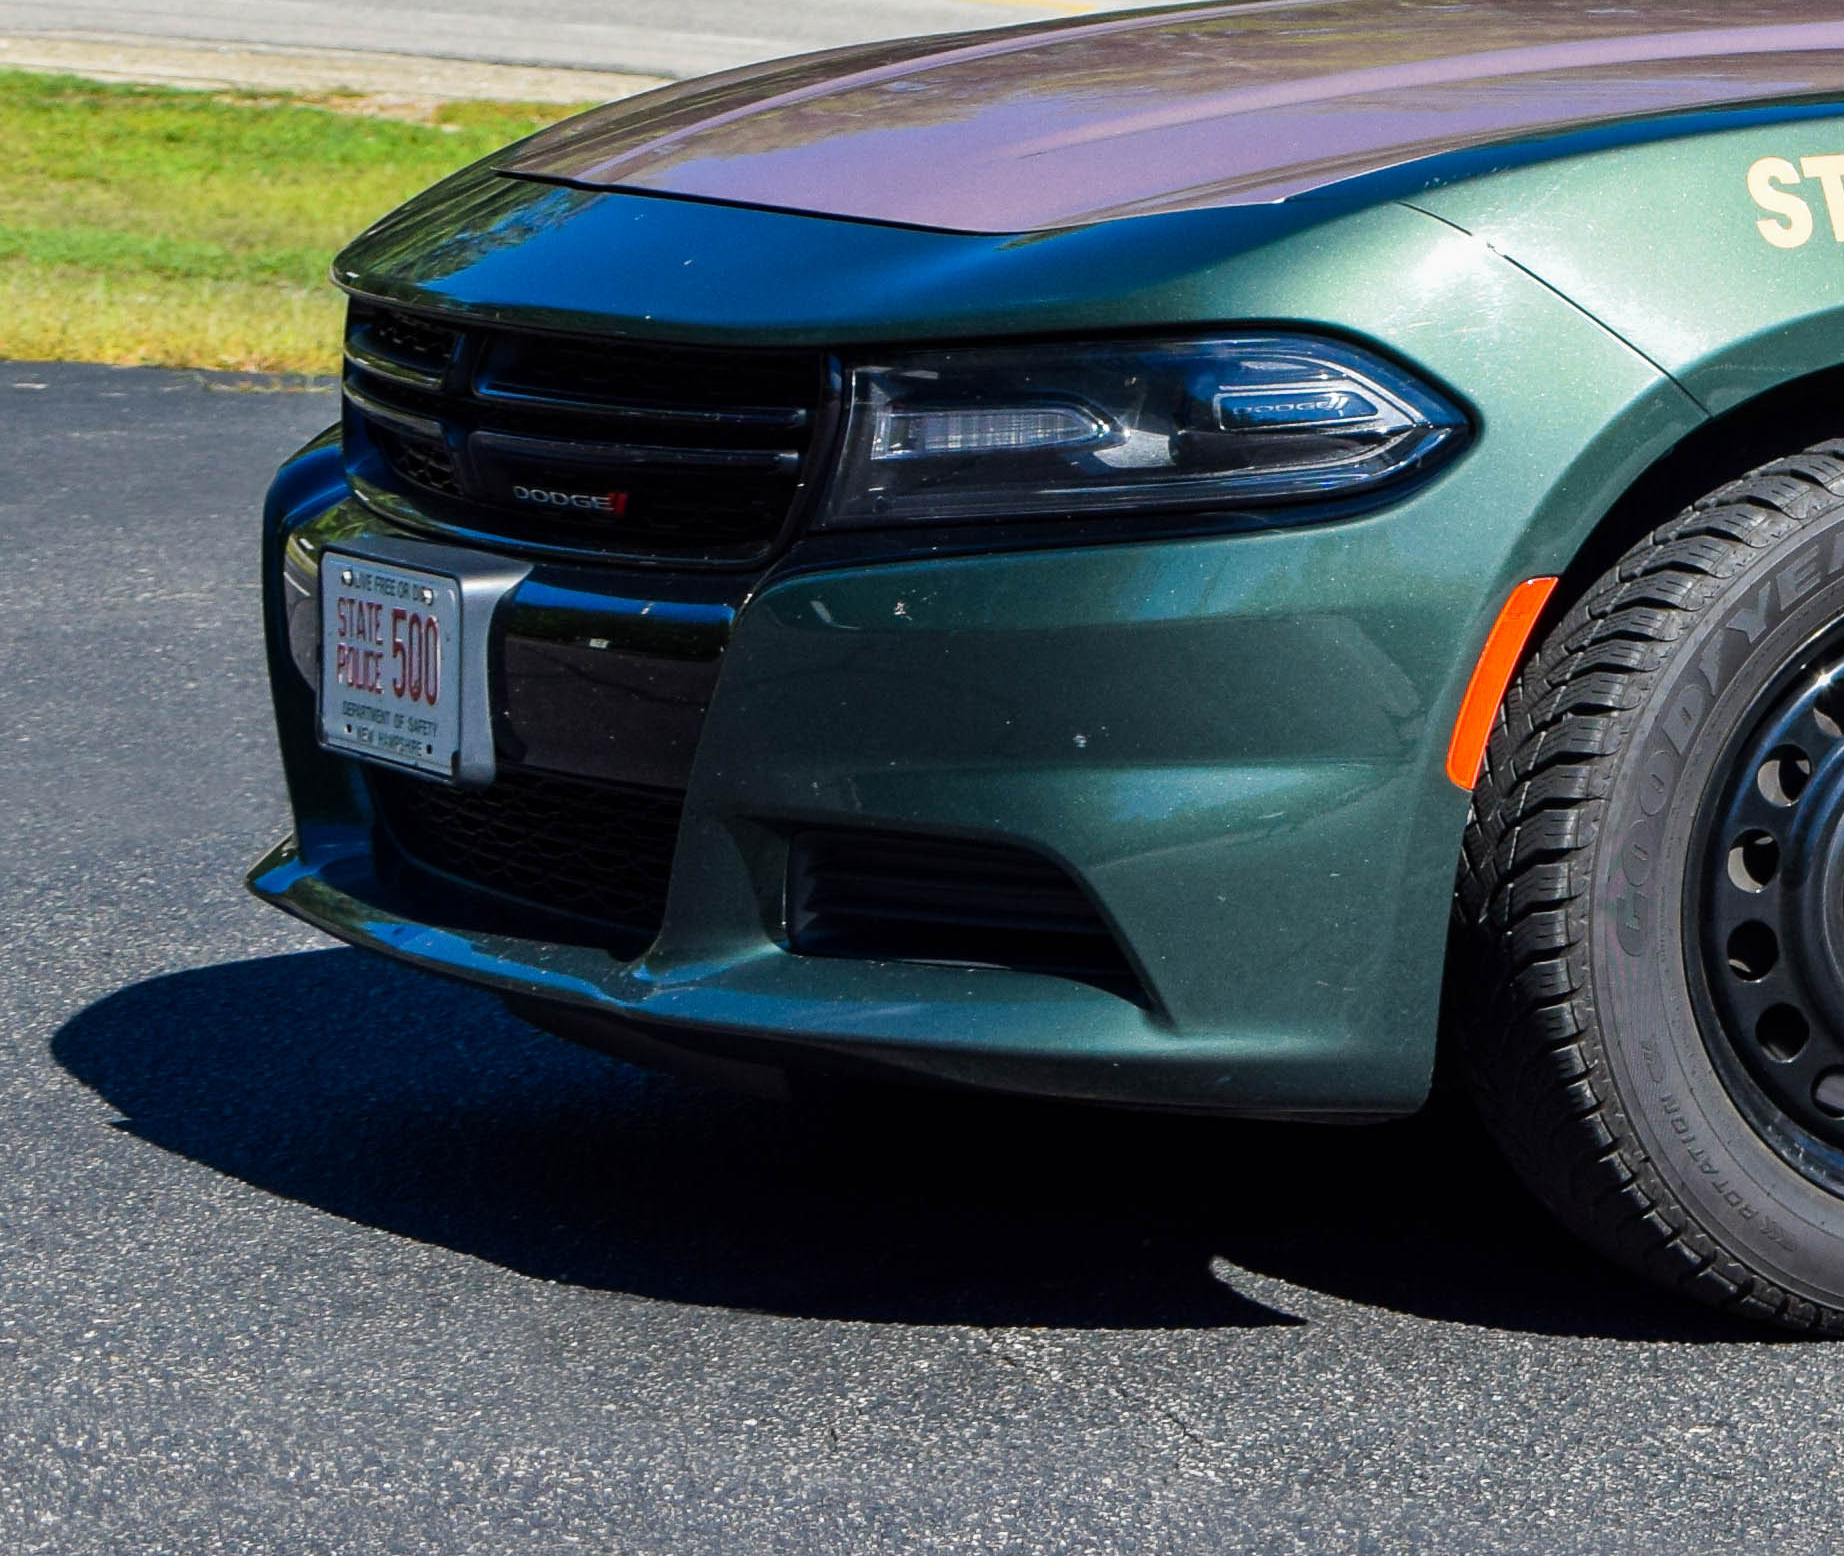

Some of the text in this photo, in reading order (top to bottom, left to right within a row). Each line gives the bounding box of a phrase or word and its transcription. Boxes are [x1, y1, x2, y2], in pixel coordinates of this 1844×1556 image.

[513, 485, 615, 511] DODGE
[375, 575, 396, 597] FREE
[398, 580, 409, 599] OR
[336, 597, 384, 646] STATE
[336, 643, 385, 694] POLICE
[391, 608, 441, 707] 500
[408, 717, 438, 738] SAFETY
[1660, 1093, 1759, 1220] ROTATION
